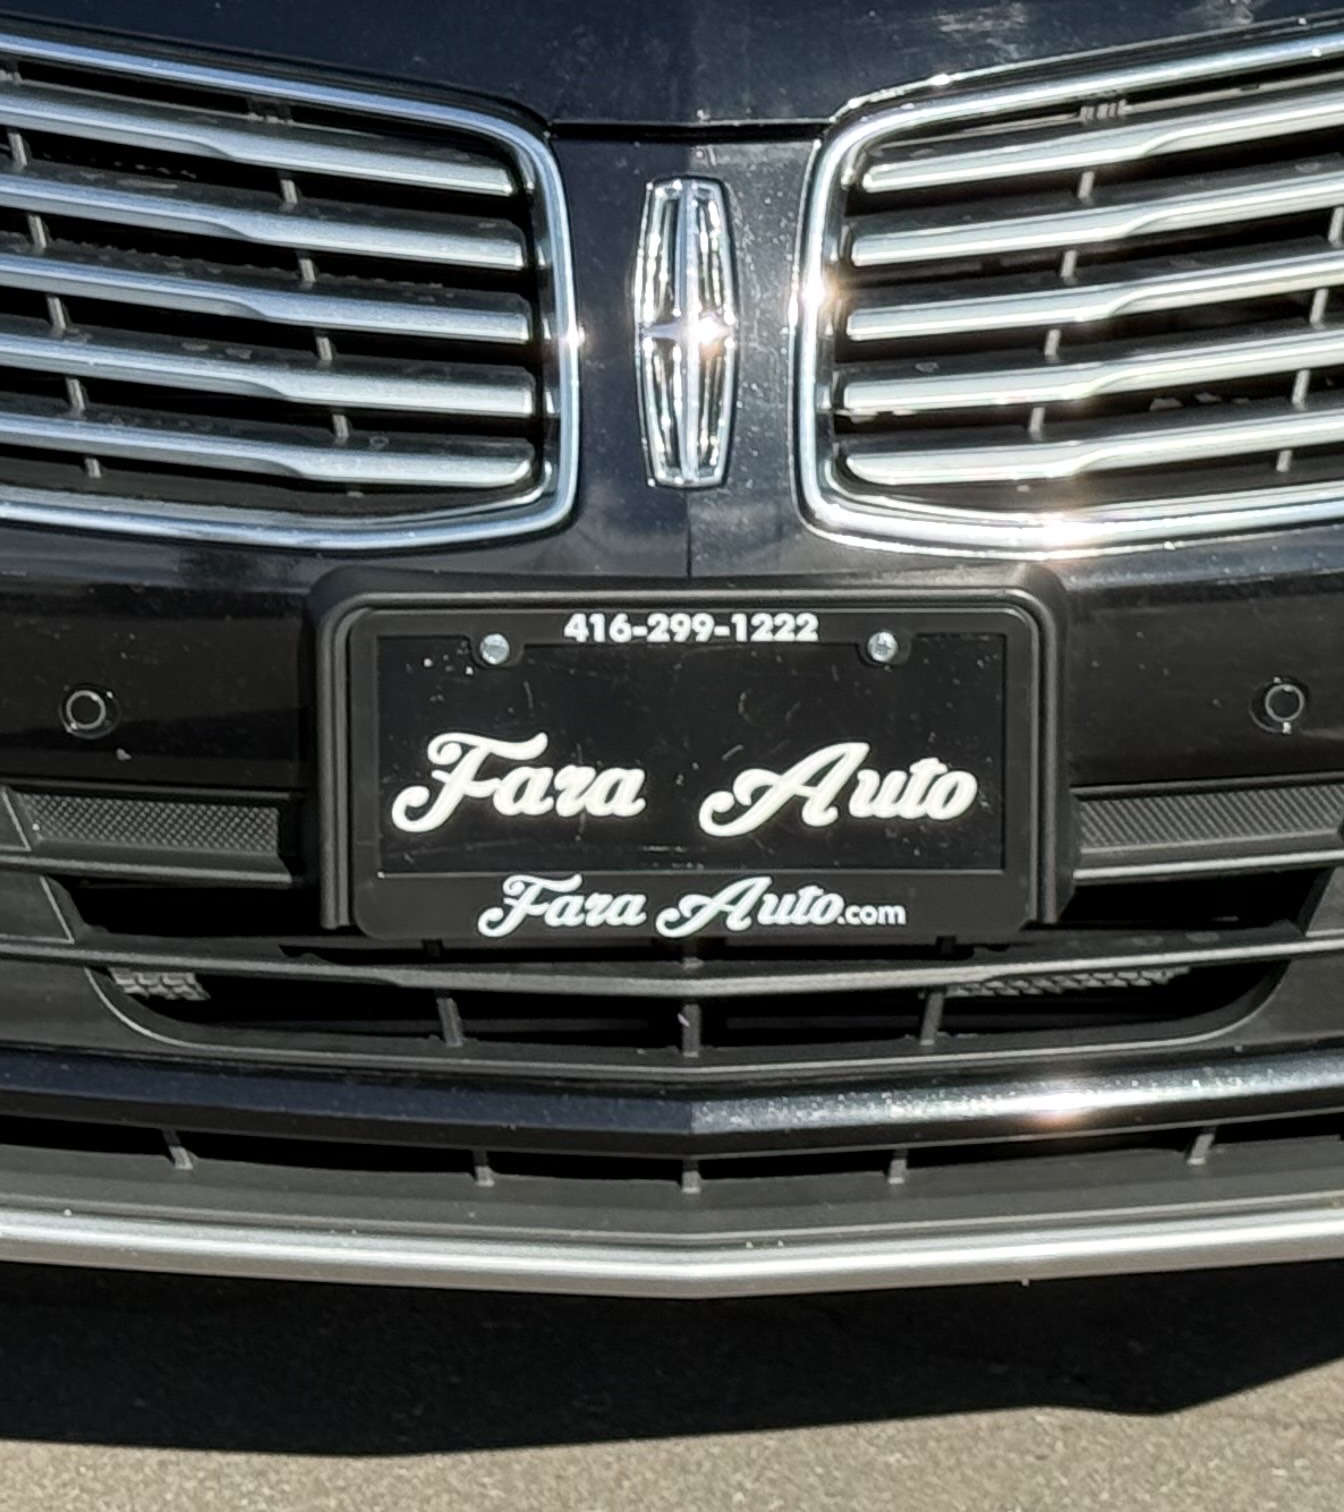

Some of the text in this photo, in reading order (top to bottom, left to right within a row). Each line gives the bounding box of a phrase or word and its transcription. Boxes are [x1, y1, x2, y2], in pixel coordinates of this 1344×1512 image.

[562, 611, 820, 644] 416-299-1222
[391, 732, 979, 838] Fara Auto
[477, 873, 907, 939] Fara Auto.com
